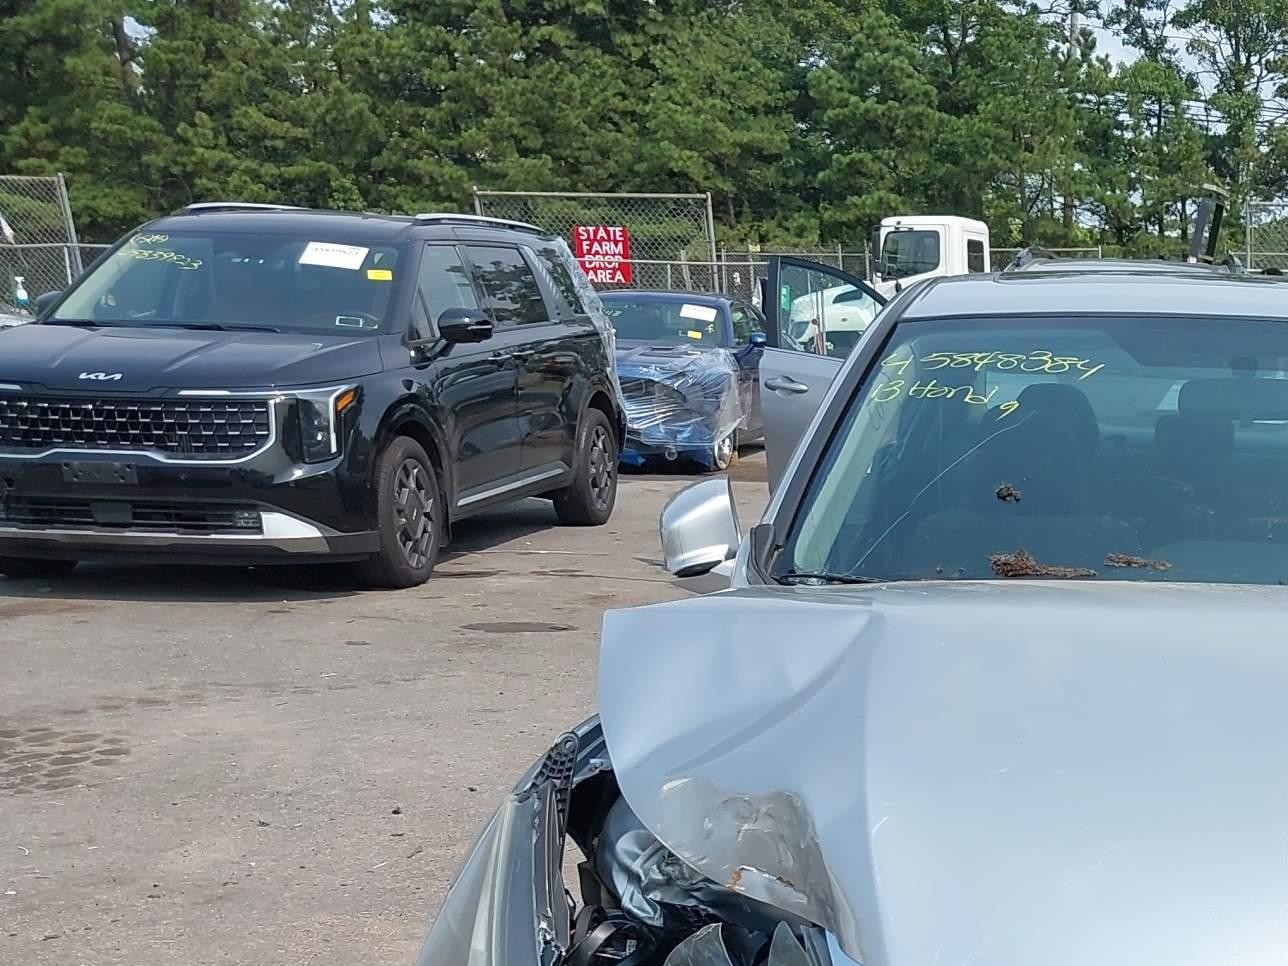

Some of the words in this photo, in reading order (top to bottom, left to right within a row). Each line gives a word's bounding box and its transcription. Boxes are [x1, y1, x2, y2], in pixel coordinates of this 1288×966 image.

[578, 226, 625, 241] STATE
[582, 241, 624, 254] FARM
[584, 254, 624, 268] DROP
[587, 270, 625, 283] AREA
